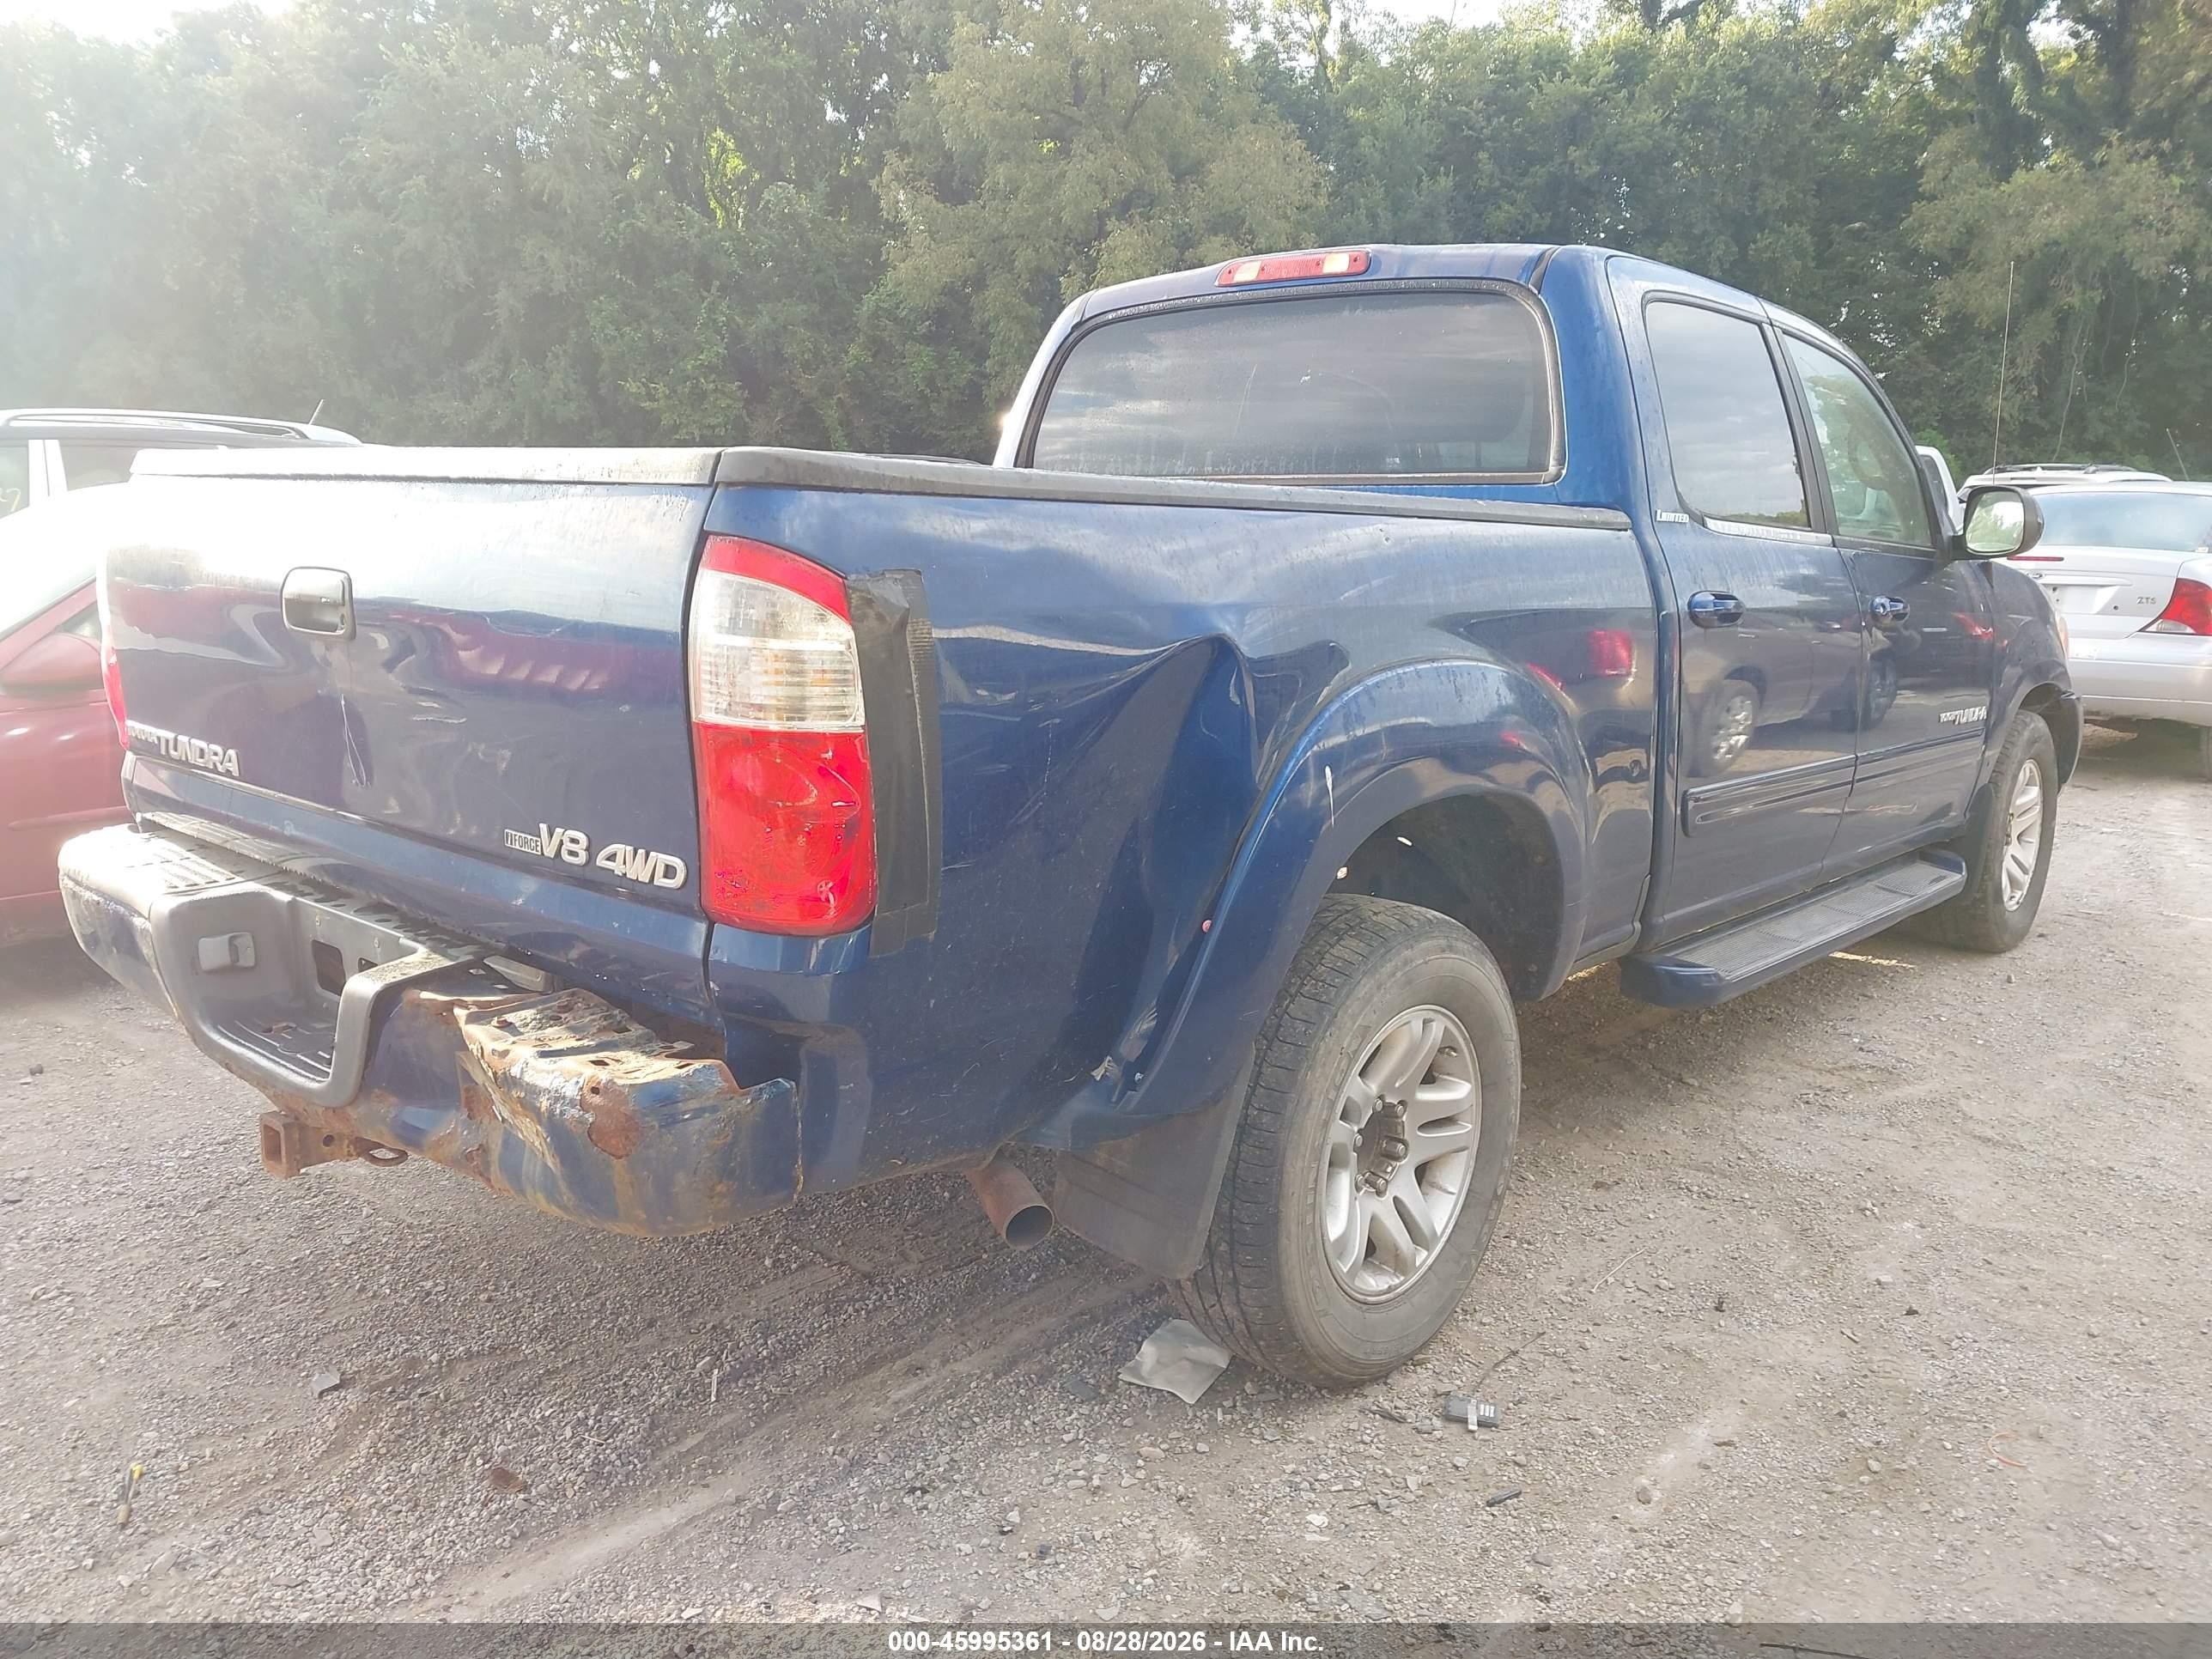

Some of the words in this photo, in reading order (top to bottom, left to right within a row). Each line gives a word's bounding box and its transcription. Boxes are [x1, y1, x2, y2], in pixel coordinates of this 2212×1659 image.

[2136, 596, 2157, 605] ZTS
[156, 727, 240, 776] TUNDRA
[538, 823, 590, 866] V8
[596, 843, 688, 890] 4WD
